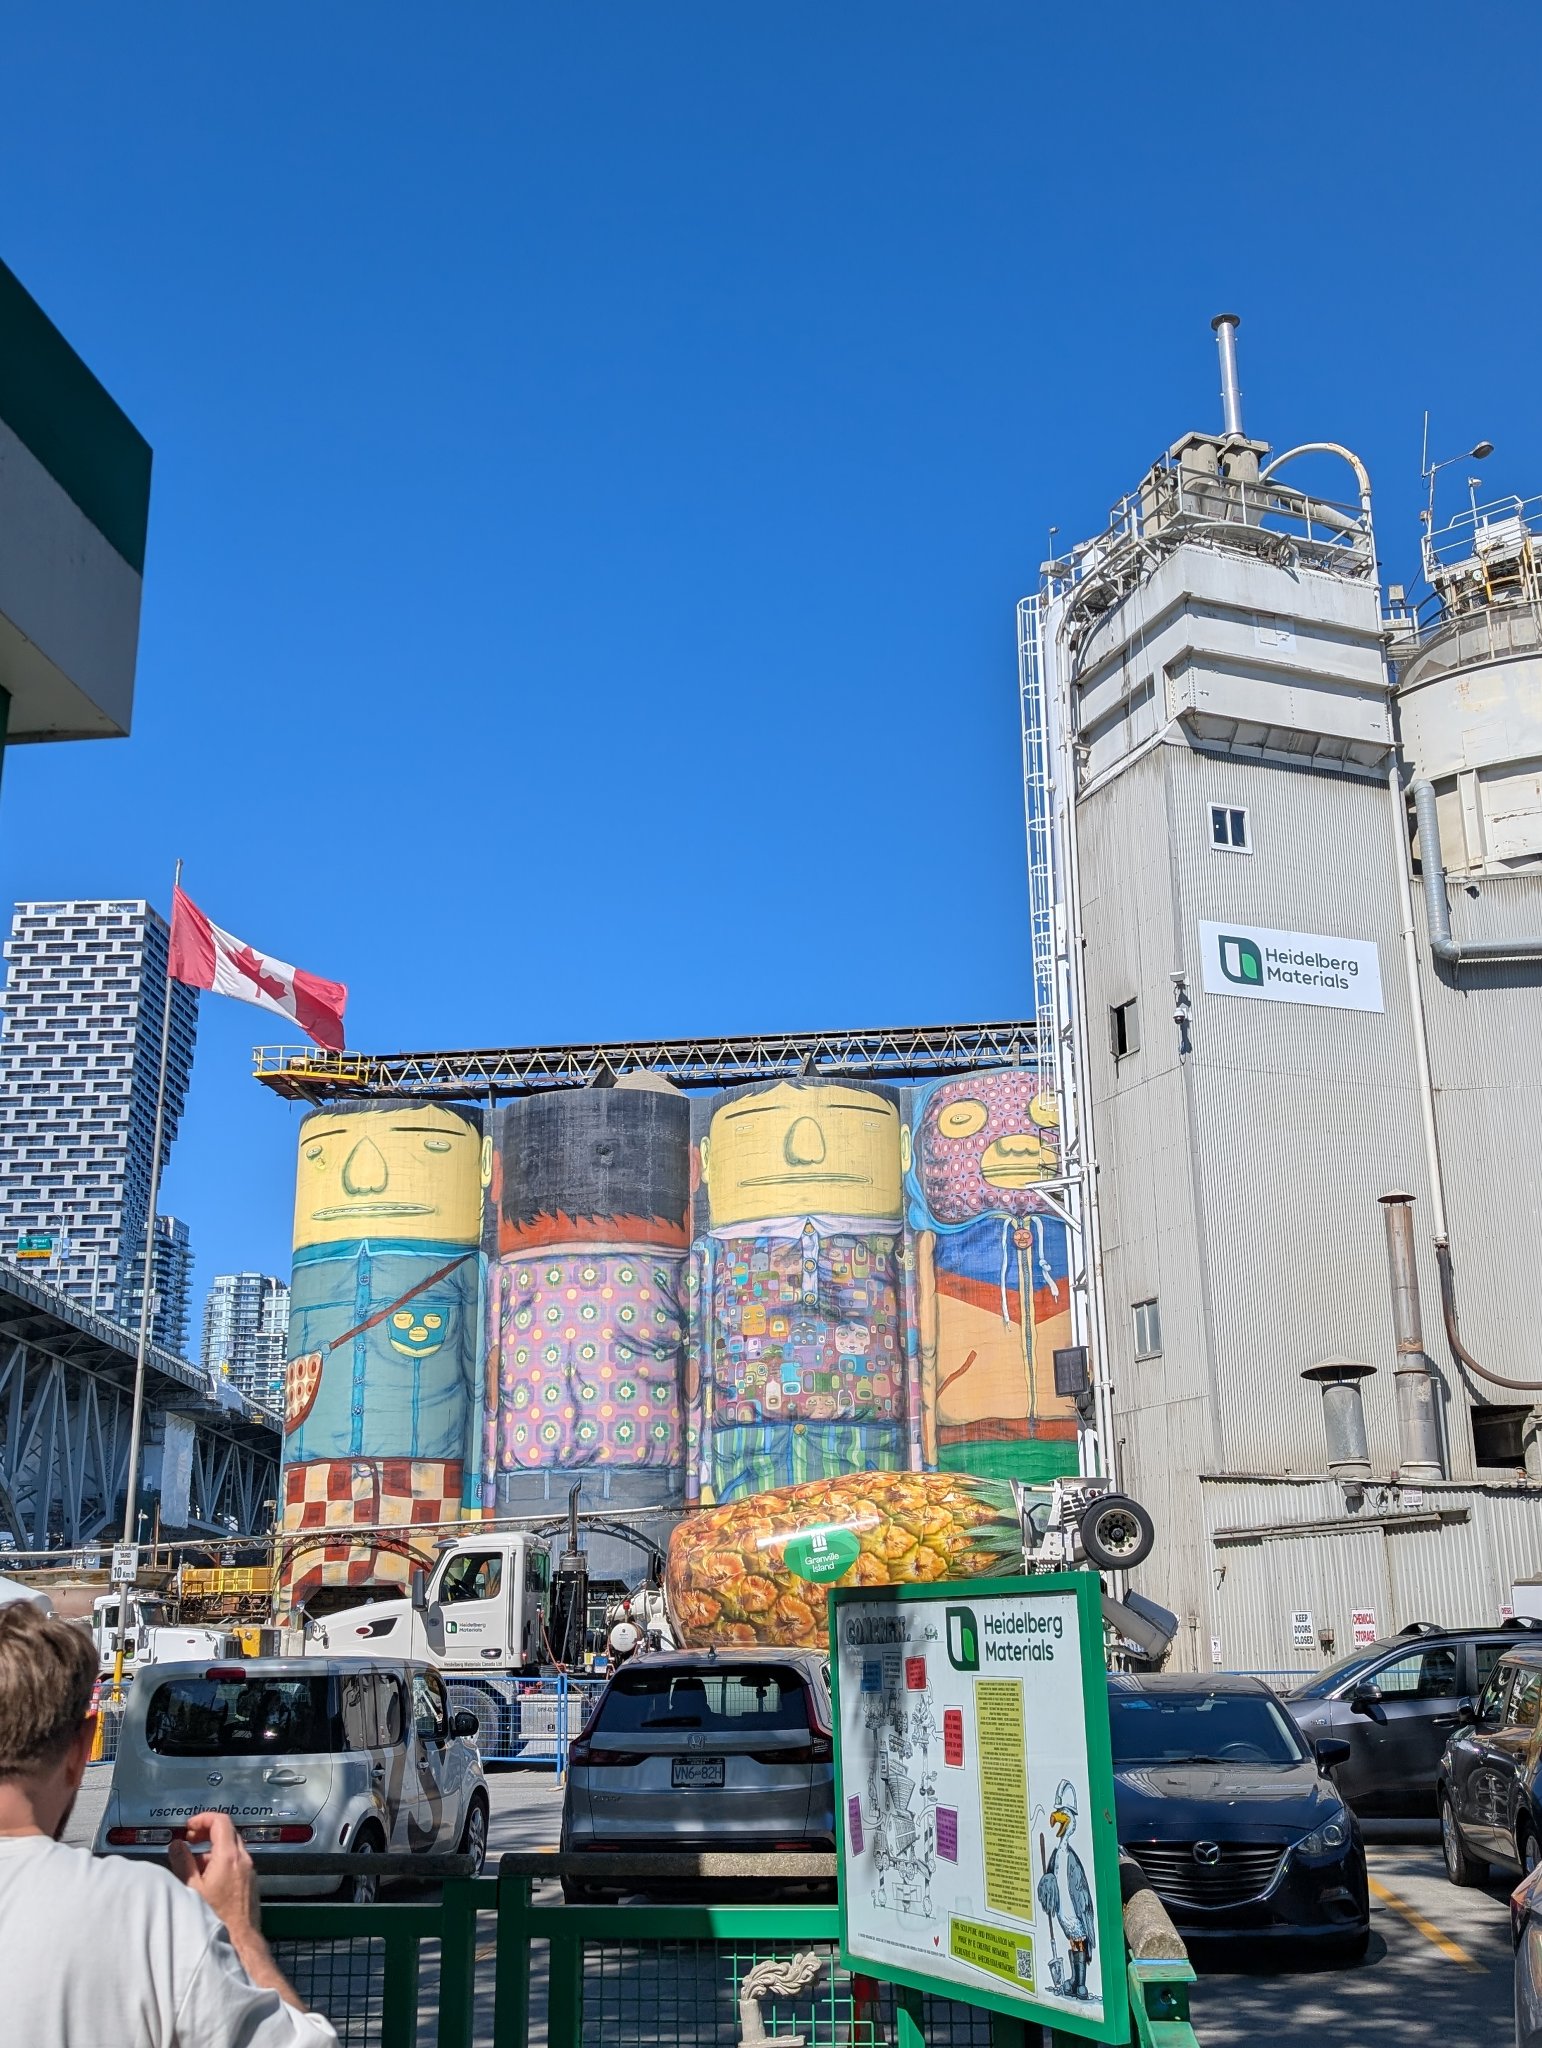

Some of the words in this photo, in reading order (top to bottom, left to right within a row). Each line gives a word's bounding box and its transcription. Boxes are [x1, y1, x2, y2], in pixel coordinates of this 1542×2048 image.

[1265, 948, 1359, 976] Heidelberg
[1267, 966, 1349, 990] Materials
[805, 1552, 840, 1565] Granville
[113, 1566, 123, 1579] 10
[812, 1562, 835, 1573] Island
[1295, 1613, 1309, 1623] KEEP
[1353, 1613, 1375, 1625] CHEMICAL
[984, 1611, 1063, 1639] Heidelberg
[1294, 1625, 1312, 1634] DOORS
[1294, 1635, 1314, 1645] CLOSED
[1355, 1630, 1376, 1643] STORAGE
[986, 1639, 1055, 1661] Materials
[149, 1804, 273, 1817] vscreativelab.com
